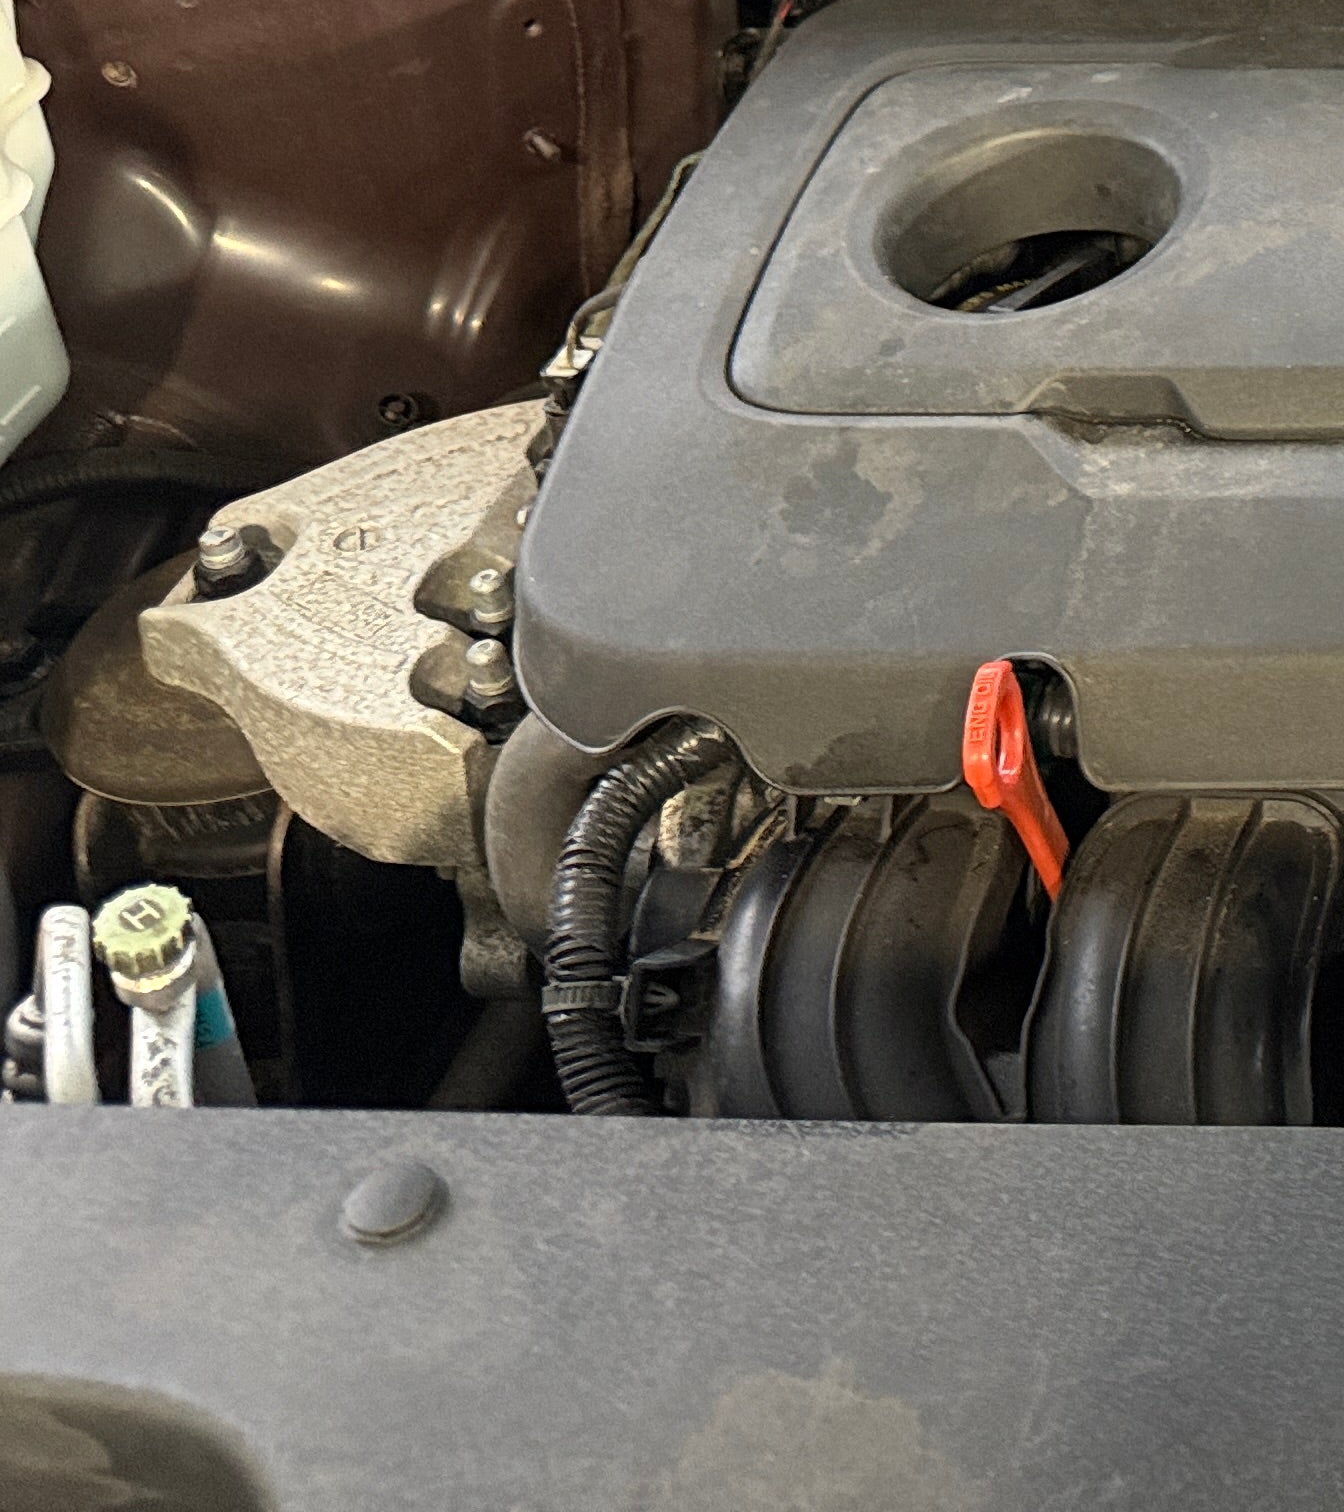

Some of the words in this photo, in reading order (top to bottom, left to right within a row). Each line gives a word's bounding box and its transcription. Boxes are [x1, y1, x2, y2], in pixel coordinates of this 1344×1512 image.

[976, 671, 997, 697] OIL
[969, 702, 989, 745] ENG
[119, 899, 161, 930] H
